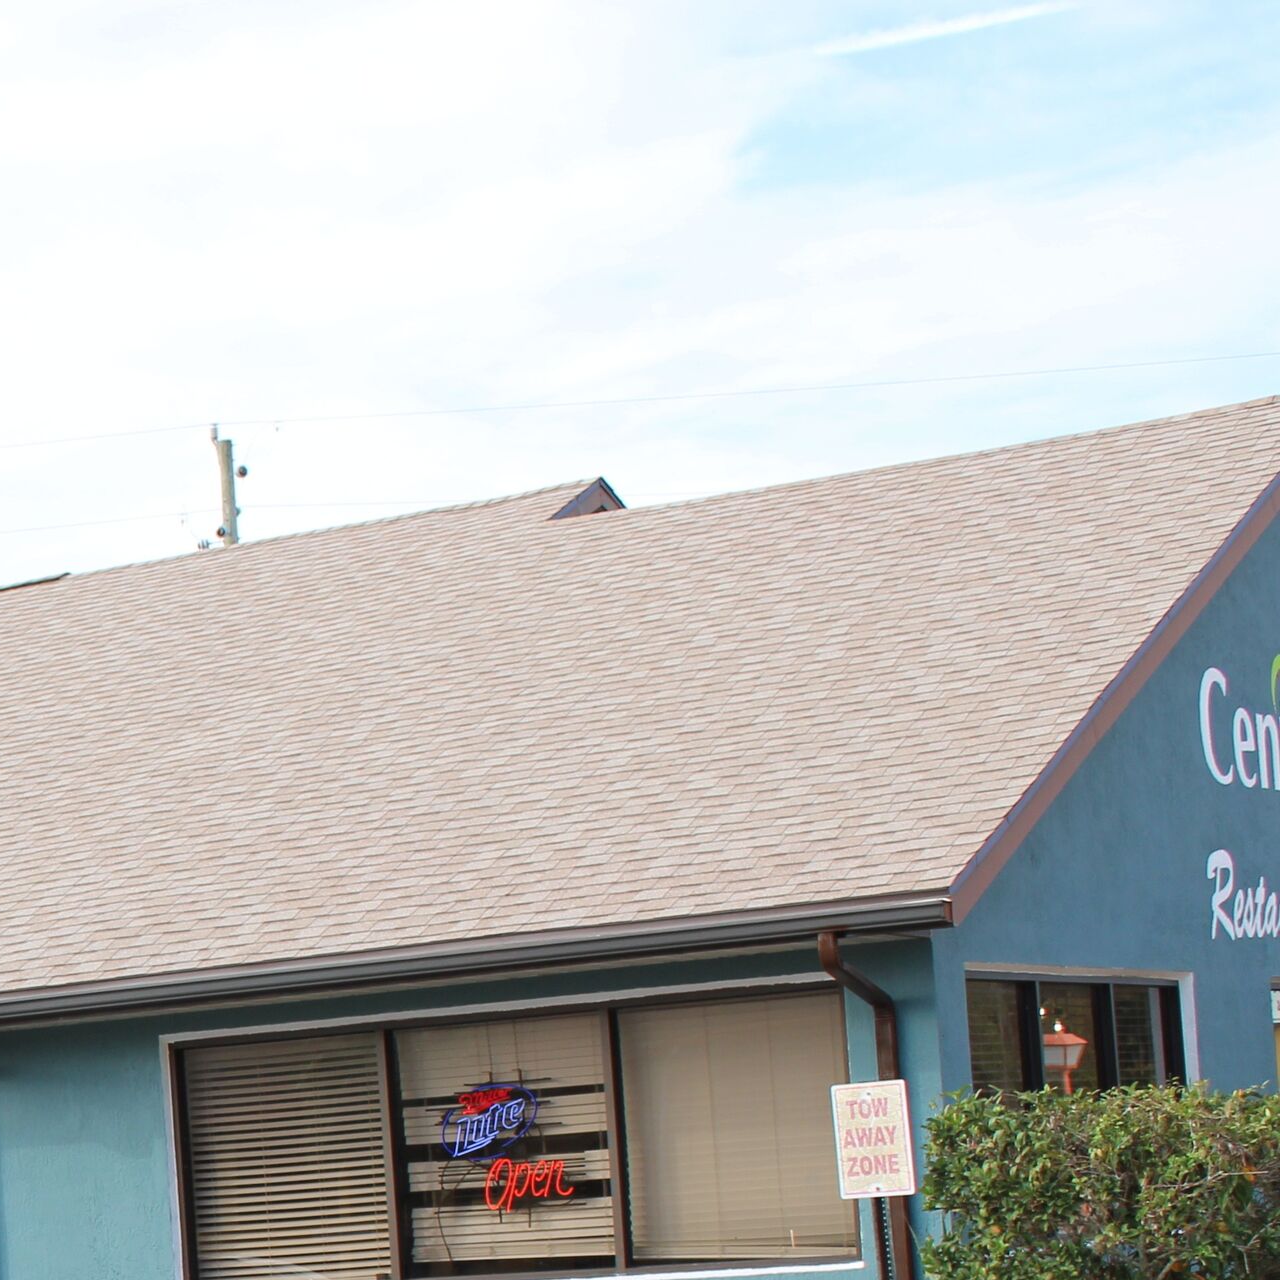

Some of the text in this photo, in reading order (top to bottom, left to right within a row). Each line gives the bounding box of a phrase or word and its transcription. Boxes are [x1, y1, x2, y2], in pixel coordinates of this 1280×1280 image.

[846, 1097, 888, 1120] TOW
[452, 1098, 525, 1157] Lite
[843, 1126, 897, 1148] AWAY
[847, 1154, 900, 1177] ZONE
[485, 1158, 574, 1213] Open
